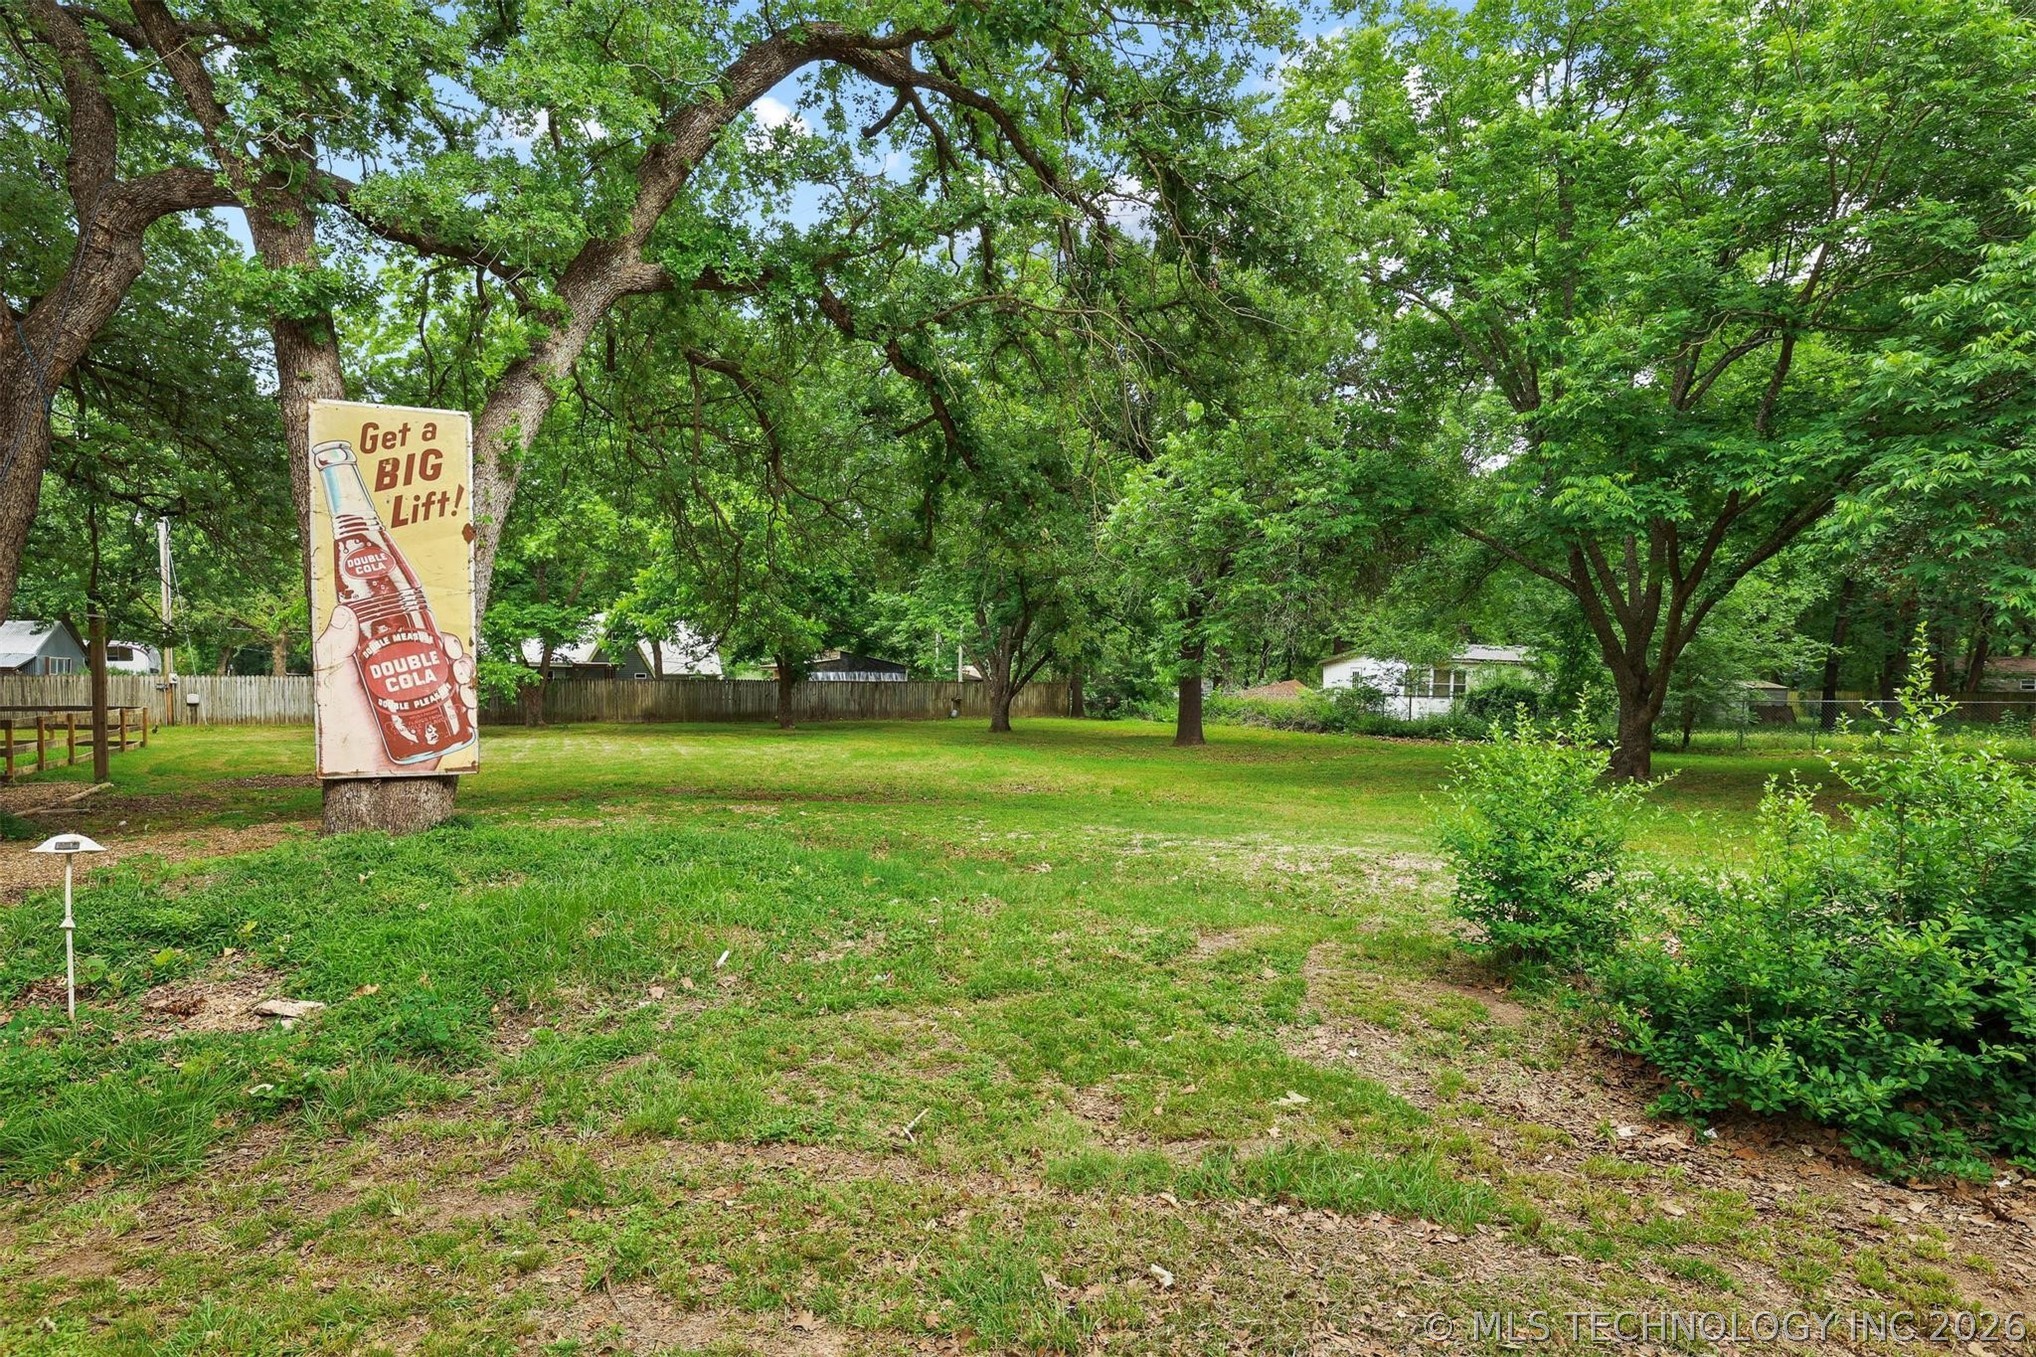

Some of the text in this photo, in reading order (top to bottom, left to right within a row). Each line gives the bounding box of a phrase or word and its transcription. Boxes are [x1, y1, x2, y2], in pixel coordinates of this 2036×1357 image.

[360, 422, 437, 454] Get a
[374, 448, 443, 492] BIG
[391, 483, 465, 528] Lift!
[347, 552, 388, 568] DOUBLE
[355, 562, 386, 575] COLA
[362, 630, 434, 659] DOLE MEAS
[369, 650, 440, 679] DOUBLE
[385, 668, 437, 693] COLA
[378, 682, 452, 711] DOBLE PLEAS
